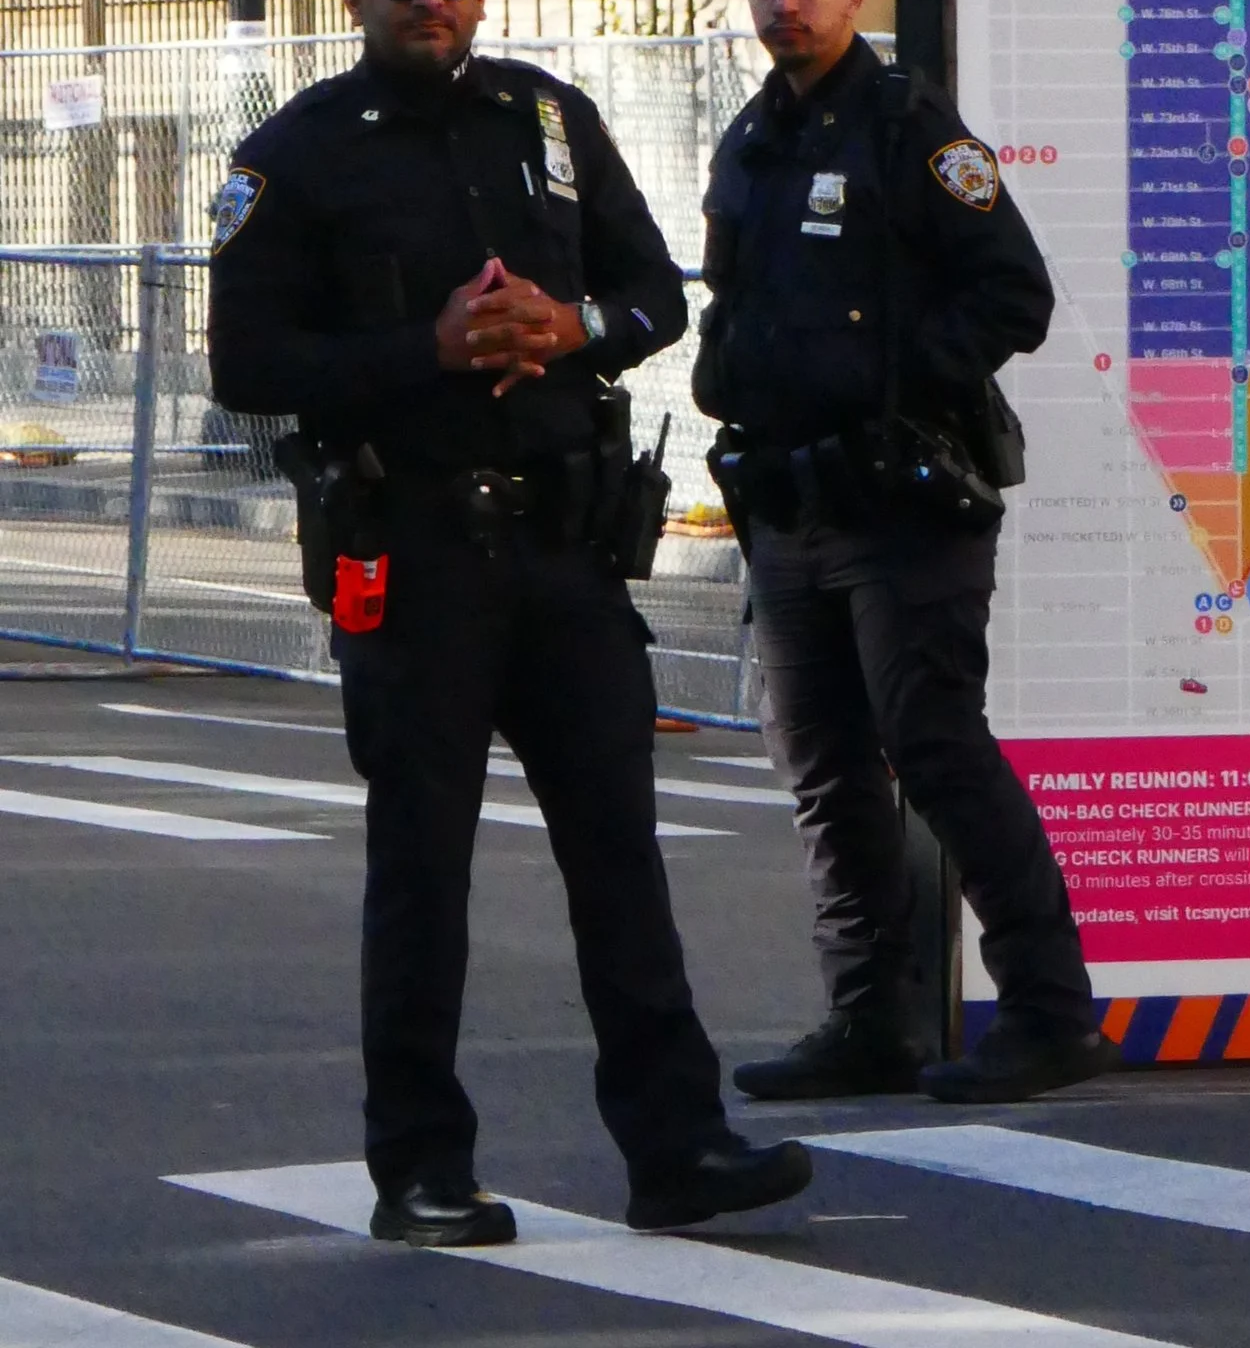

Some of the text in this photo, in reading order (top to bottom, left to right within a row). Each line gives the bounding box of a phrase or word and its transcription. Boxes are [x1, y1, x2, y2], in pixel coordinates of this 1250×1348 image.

[1029, 773, 1105, 791] FAMILY
[1111, 771, 1215, 789] REUNION:
[1037, 805, 1113, 820] ON-BAG
[1119, 804, 1179, 818] CHECK
[1072, 851, 1133, 866] CHECK
[1137, 848, 1220, 864] RUNNERS
[1224, 848, 1250, 862] will
[1086, 873, 1150, 888] minutes
[1156, 871, 1193, 886] after
[1071, 908, 1139, 925] pdates,
[1145, 907, 1179, 921] visit
